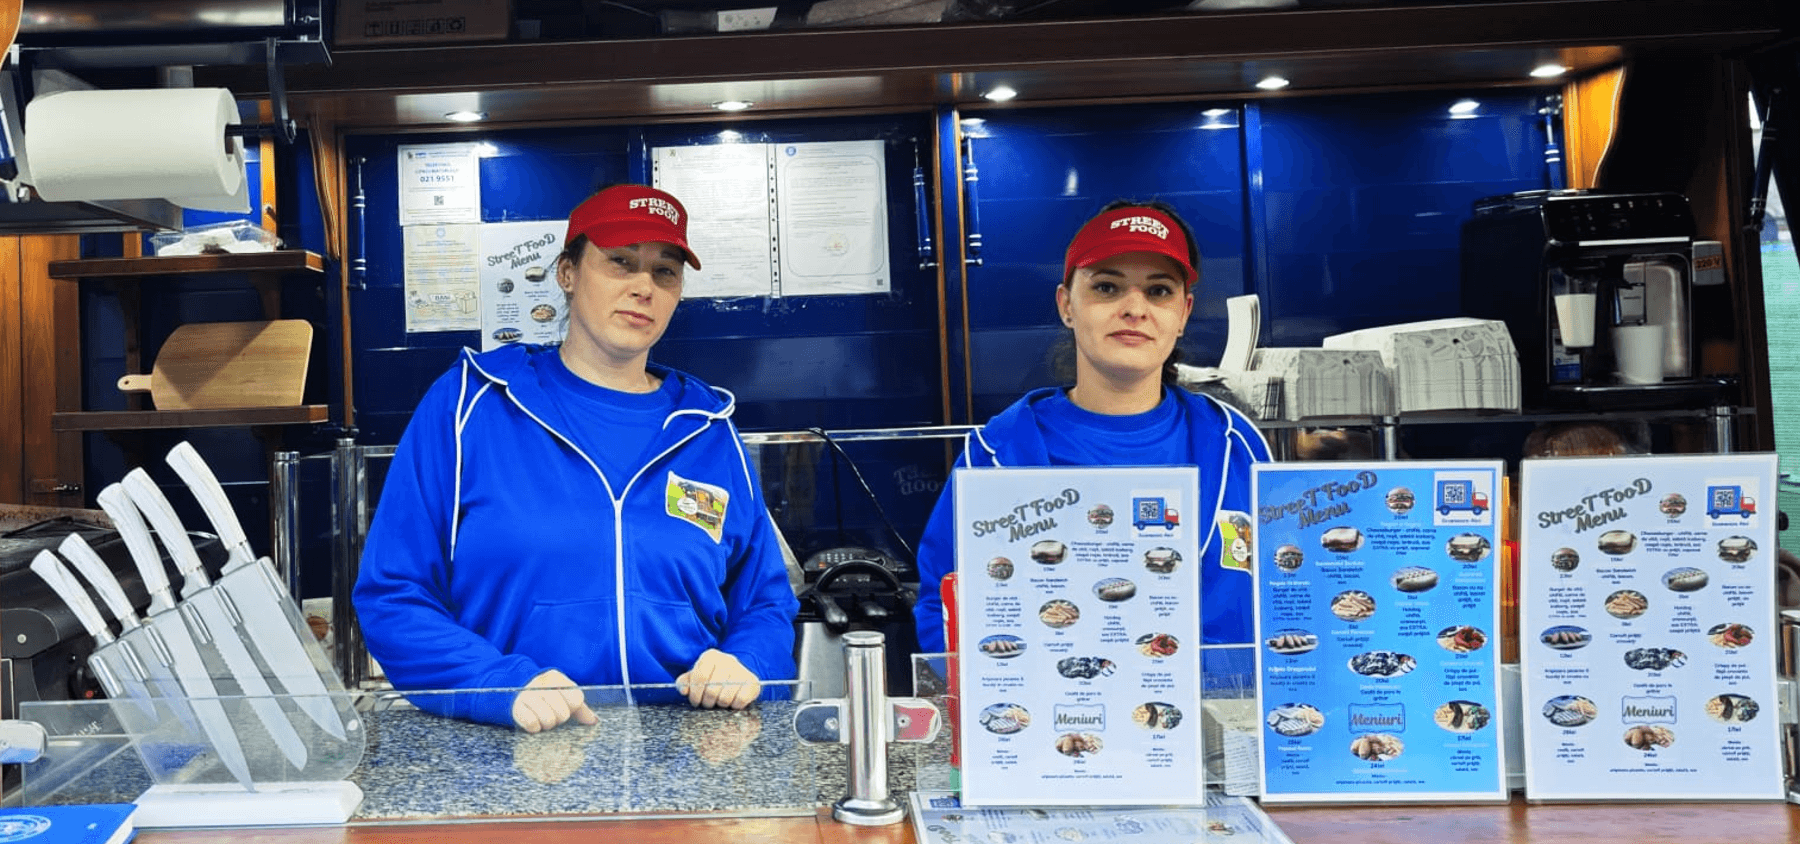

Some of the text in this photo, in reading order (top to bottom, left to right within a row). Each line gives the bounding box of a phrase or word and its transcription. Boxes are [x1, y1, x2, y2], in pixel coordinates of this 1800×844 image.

[629, 197, 680, 218] STREET
[648, 206, 678, 225] FOOD
[1110, 216, 1170, 234] STREET
[1129, 225, 1166, 240] FOOD
[510, 252, 542, 270] Menu
[1321, 470, 1378, 501] FooD
[1599, 477, 1653, 507] FooD
[1029, 488, 1080, 517] FooD
[1298, 502, 1353, 530] Menu
[1574, 507, 1627, 533] Menu
[1008, 517, 1058, 543] Menu
[1054, 713, 1103, 725] Meniuri
[1351, 713, 1403, 726] Meniuri
[1622, 705, 1675, 718] Meniuri
